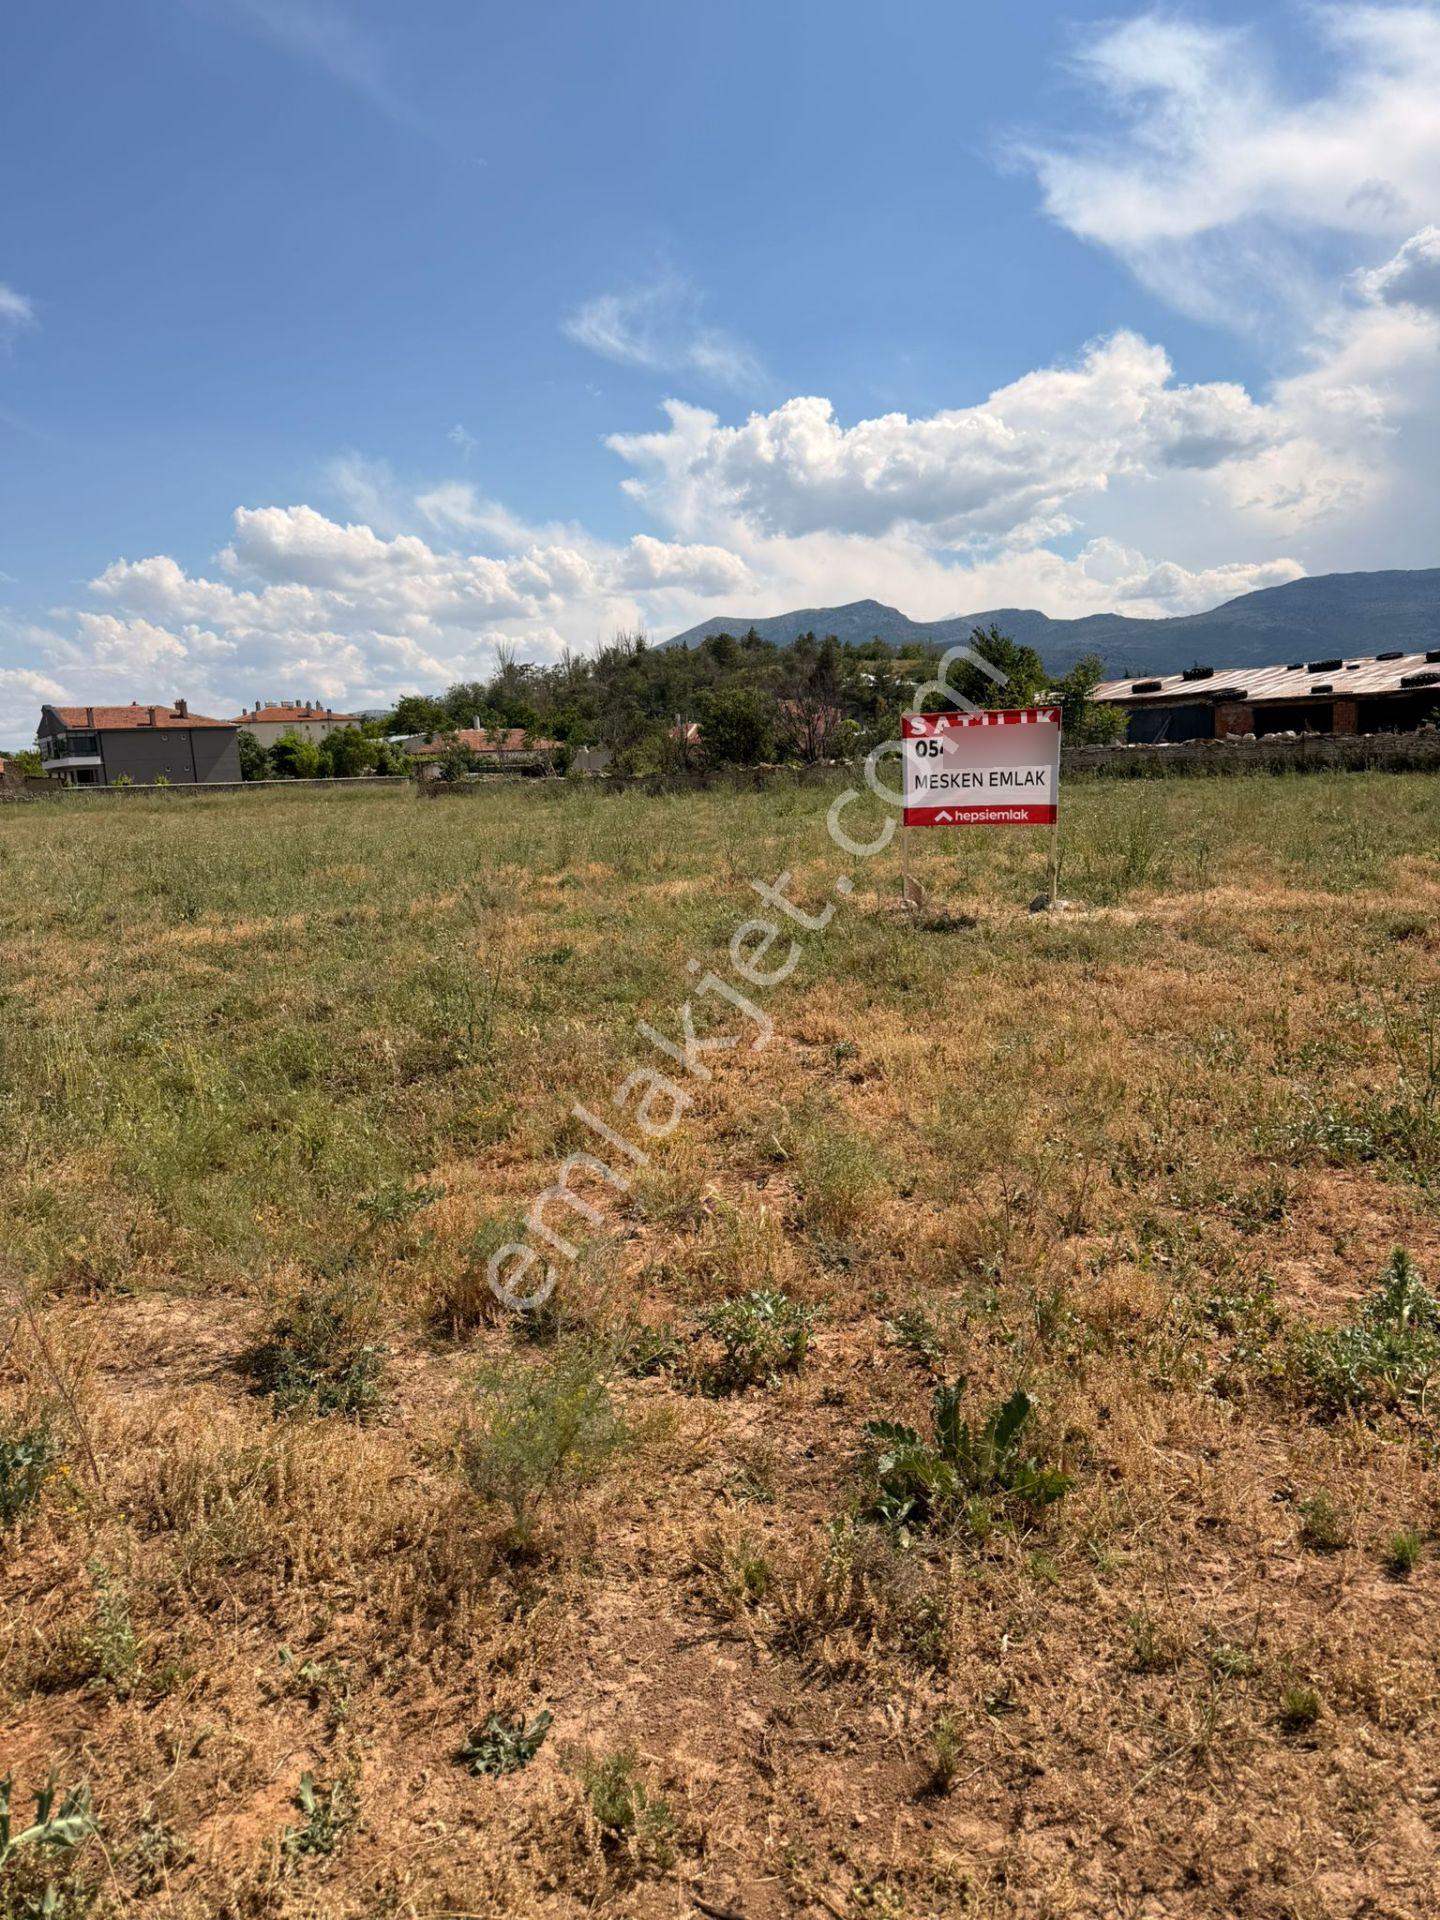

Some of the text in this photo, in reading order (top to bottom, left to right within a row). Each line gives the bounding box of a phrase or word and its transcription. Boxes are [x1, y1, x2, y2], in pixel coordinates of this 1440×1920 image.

[915, 740, 944, 758] 05
[915, 770, 1045, 790] MESKEN EMLAK
[955, 809, 1029, 822] hepsiemlak
